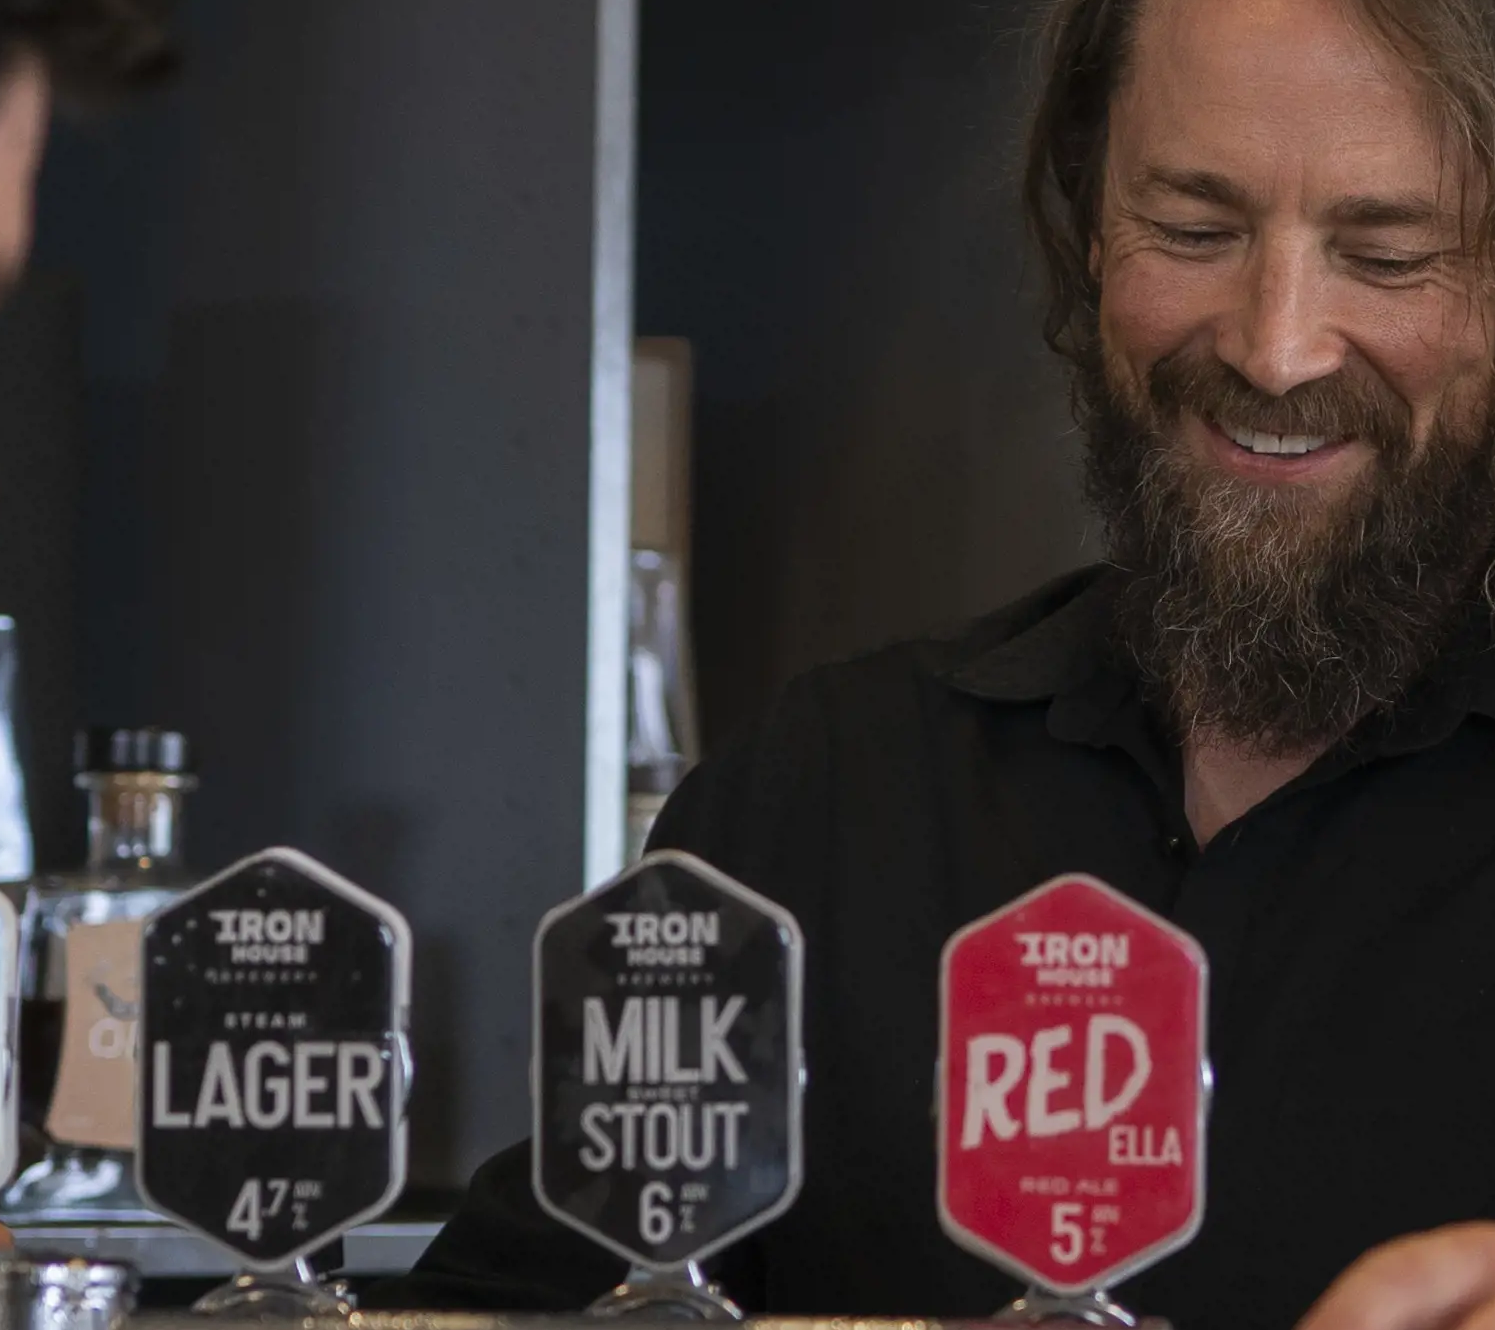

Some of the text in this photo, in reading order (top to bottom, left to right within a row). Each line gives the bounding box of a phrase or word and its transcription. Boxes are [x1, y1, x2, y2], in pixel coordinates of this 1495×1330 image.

[208, 910, 325, 944] IRON
[605, 911, 720, 946] IRON
[231, 944, 307, 964] HOUSE
[627, 946, 705, 967] HOUSE
[1013, 931, 1130, 968] IRON
[224, 1012, 306, 1029] STEAM
[582, 994, 749, 1085] MILK
[153, 1040, 385, 1130] LAGER
[960, 1012, 1152, 1151] RED
[578, 1101, 750, 1171] STOUT
[1108, 1125, 1184, 1166] ELLA
[1020, 1176, 1120, 1196] RED ALE
[638, 1180, 674, 1245] 6
[1049, 1202, 1084, 1265] 5
